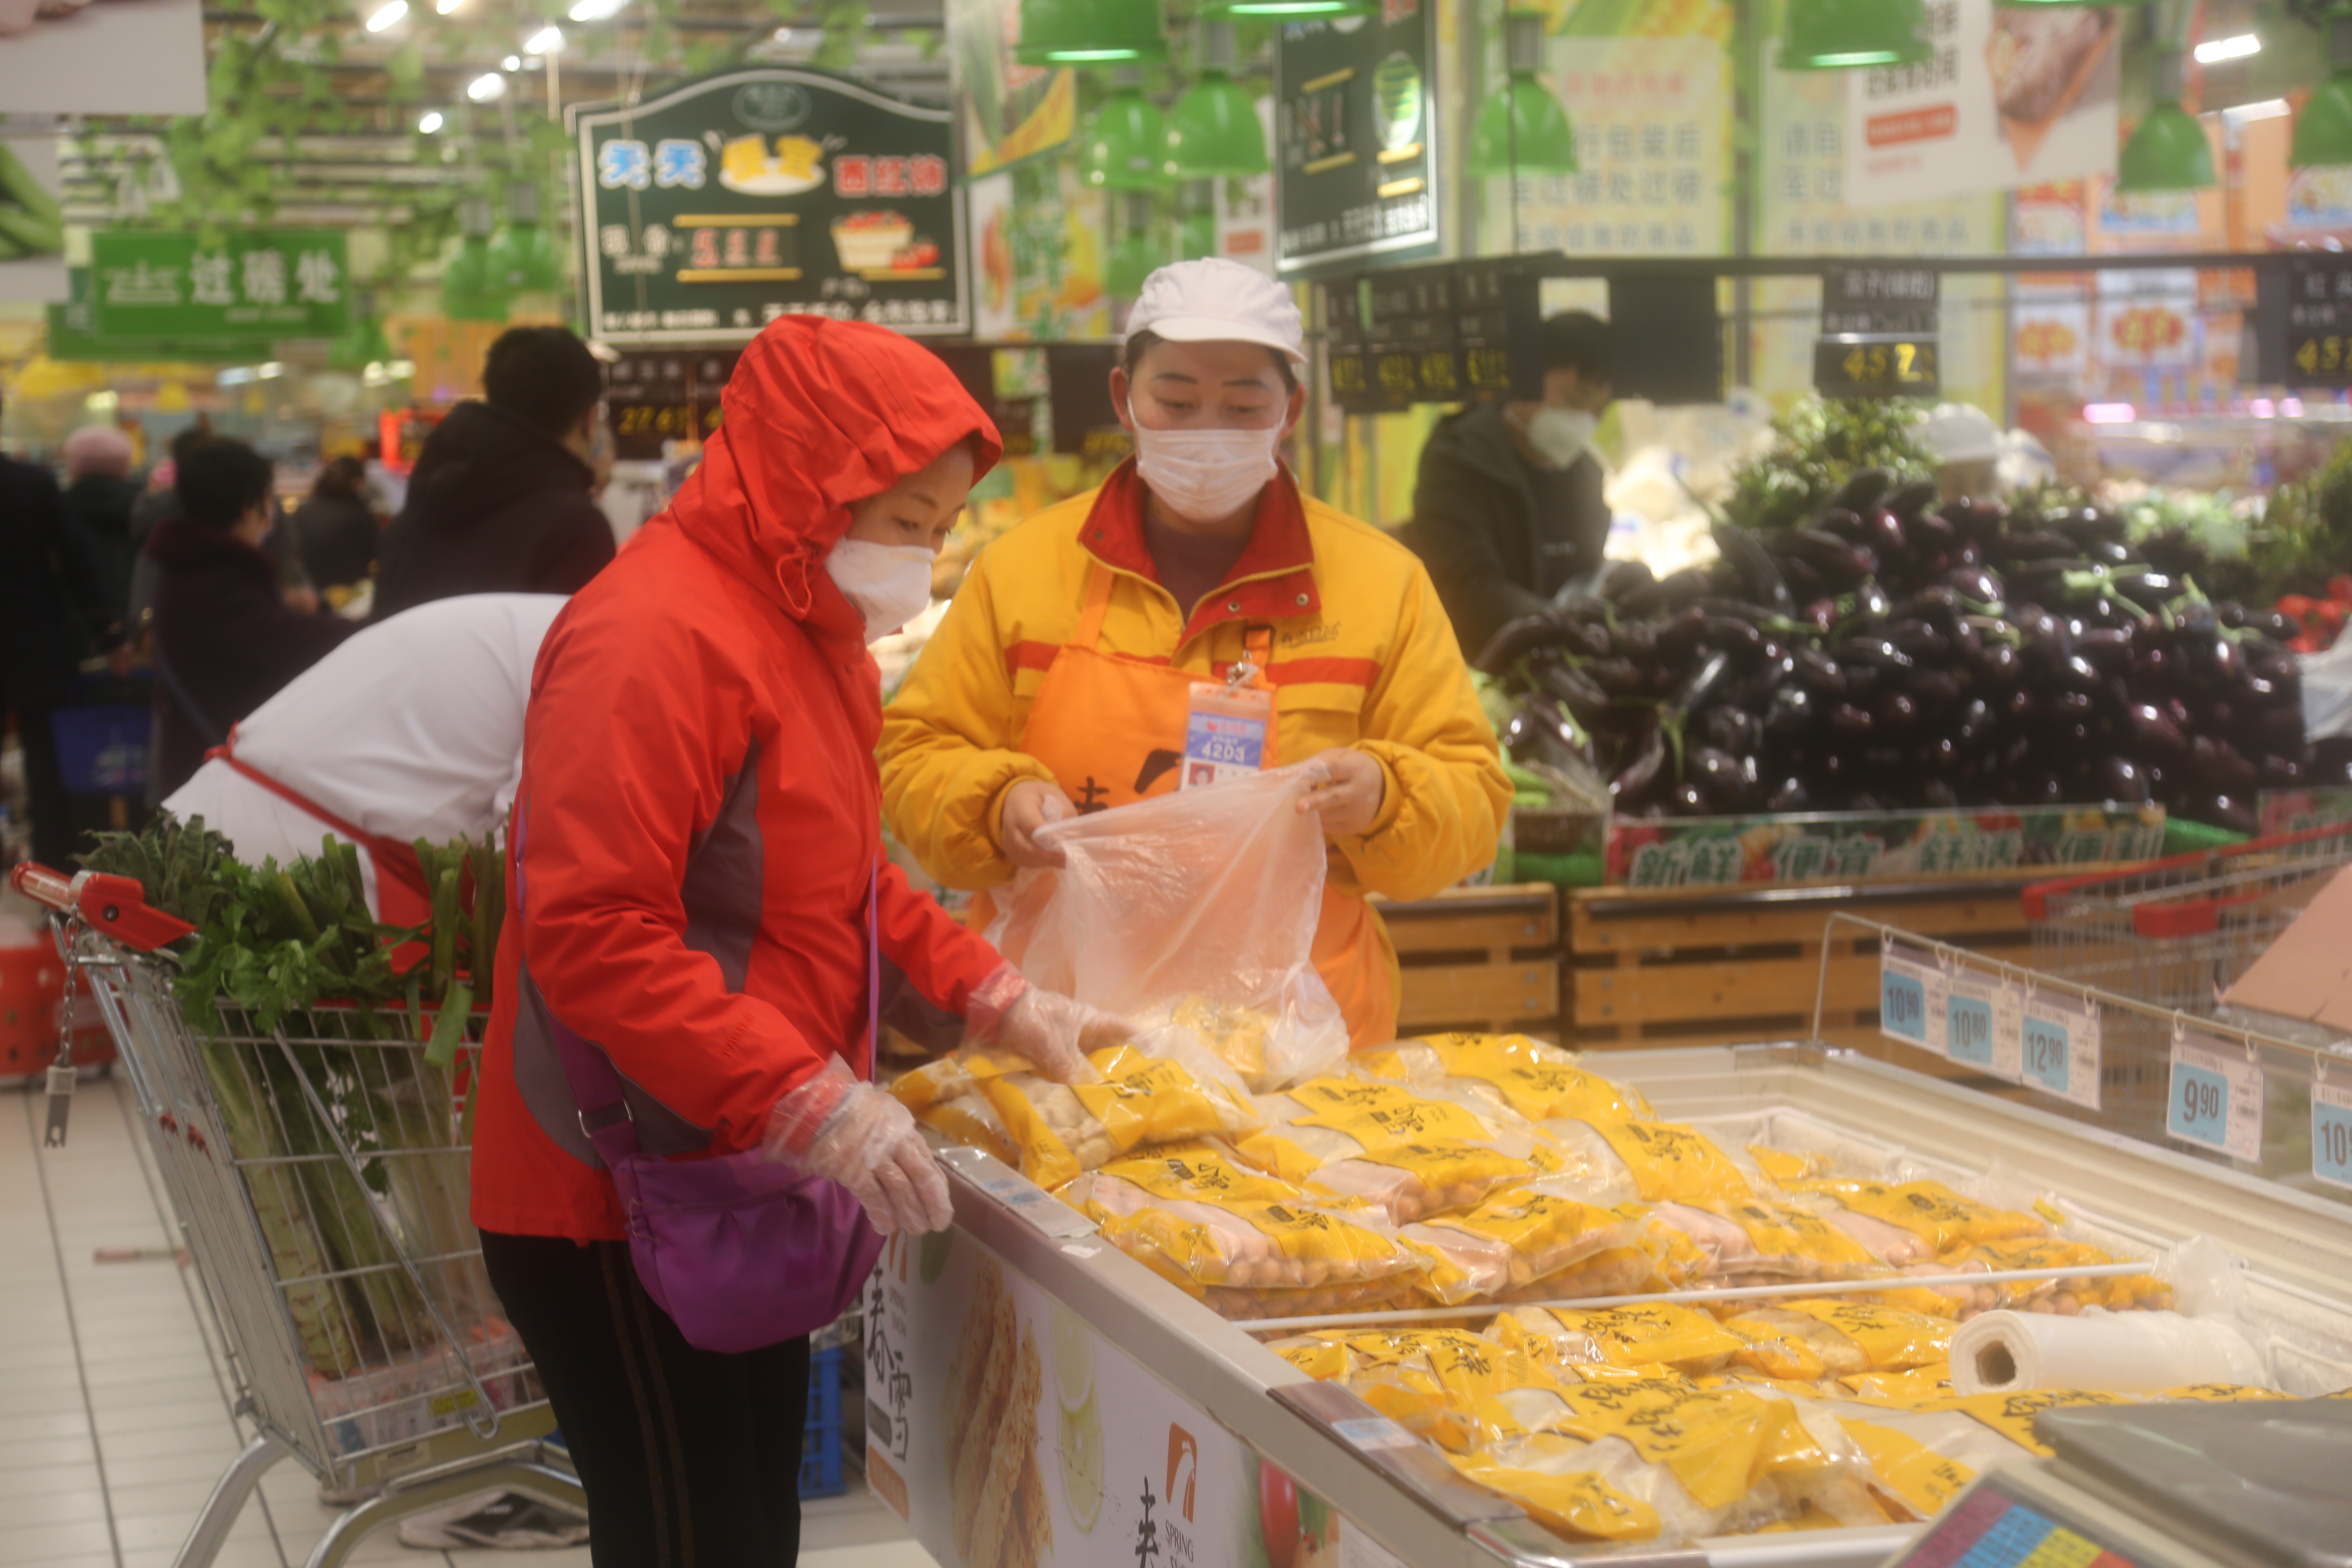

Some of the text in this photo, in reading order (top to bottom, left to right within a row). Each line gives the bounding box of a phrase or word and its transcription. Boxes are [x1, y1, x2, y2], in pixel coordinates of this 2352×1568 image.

[832, 154, 949, 199] 西红柿
[189, 248, 340, 304] 过磅处
[1202, 741, 1246, 762] 4203
[1630, 838, 1744, 886] 新鲜
[1774, 833, 1884, 879] 便宜
[1165, 1519, 1194, 1563] SPRING
